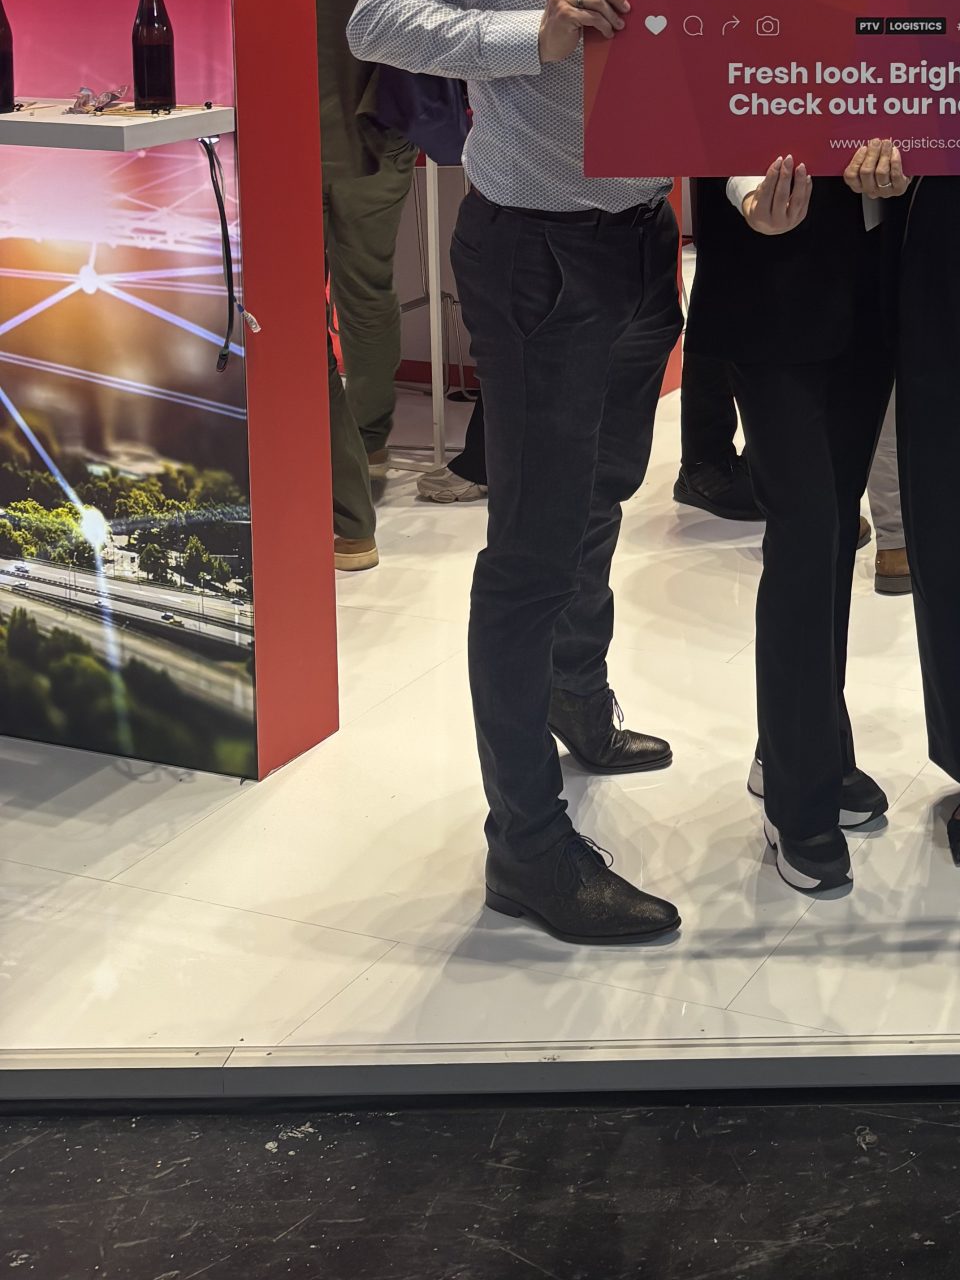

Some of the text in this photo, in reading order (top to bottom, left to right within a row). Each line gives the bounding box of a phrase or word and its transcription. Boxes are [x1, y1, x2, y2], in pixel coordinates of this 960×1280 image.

[859, 22, 880, 31] PTV
[889, 22, 942, 31] LOGISTICS
[728, 62, 808, 84] Fresh
[815, 62, 883, 84] look.
[729, 92, 823, 116] Check
[828, 93, 877, 115] out
[883, 96, 933, 115] our
